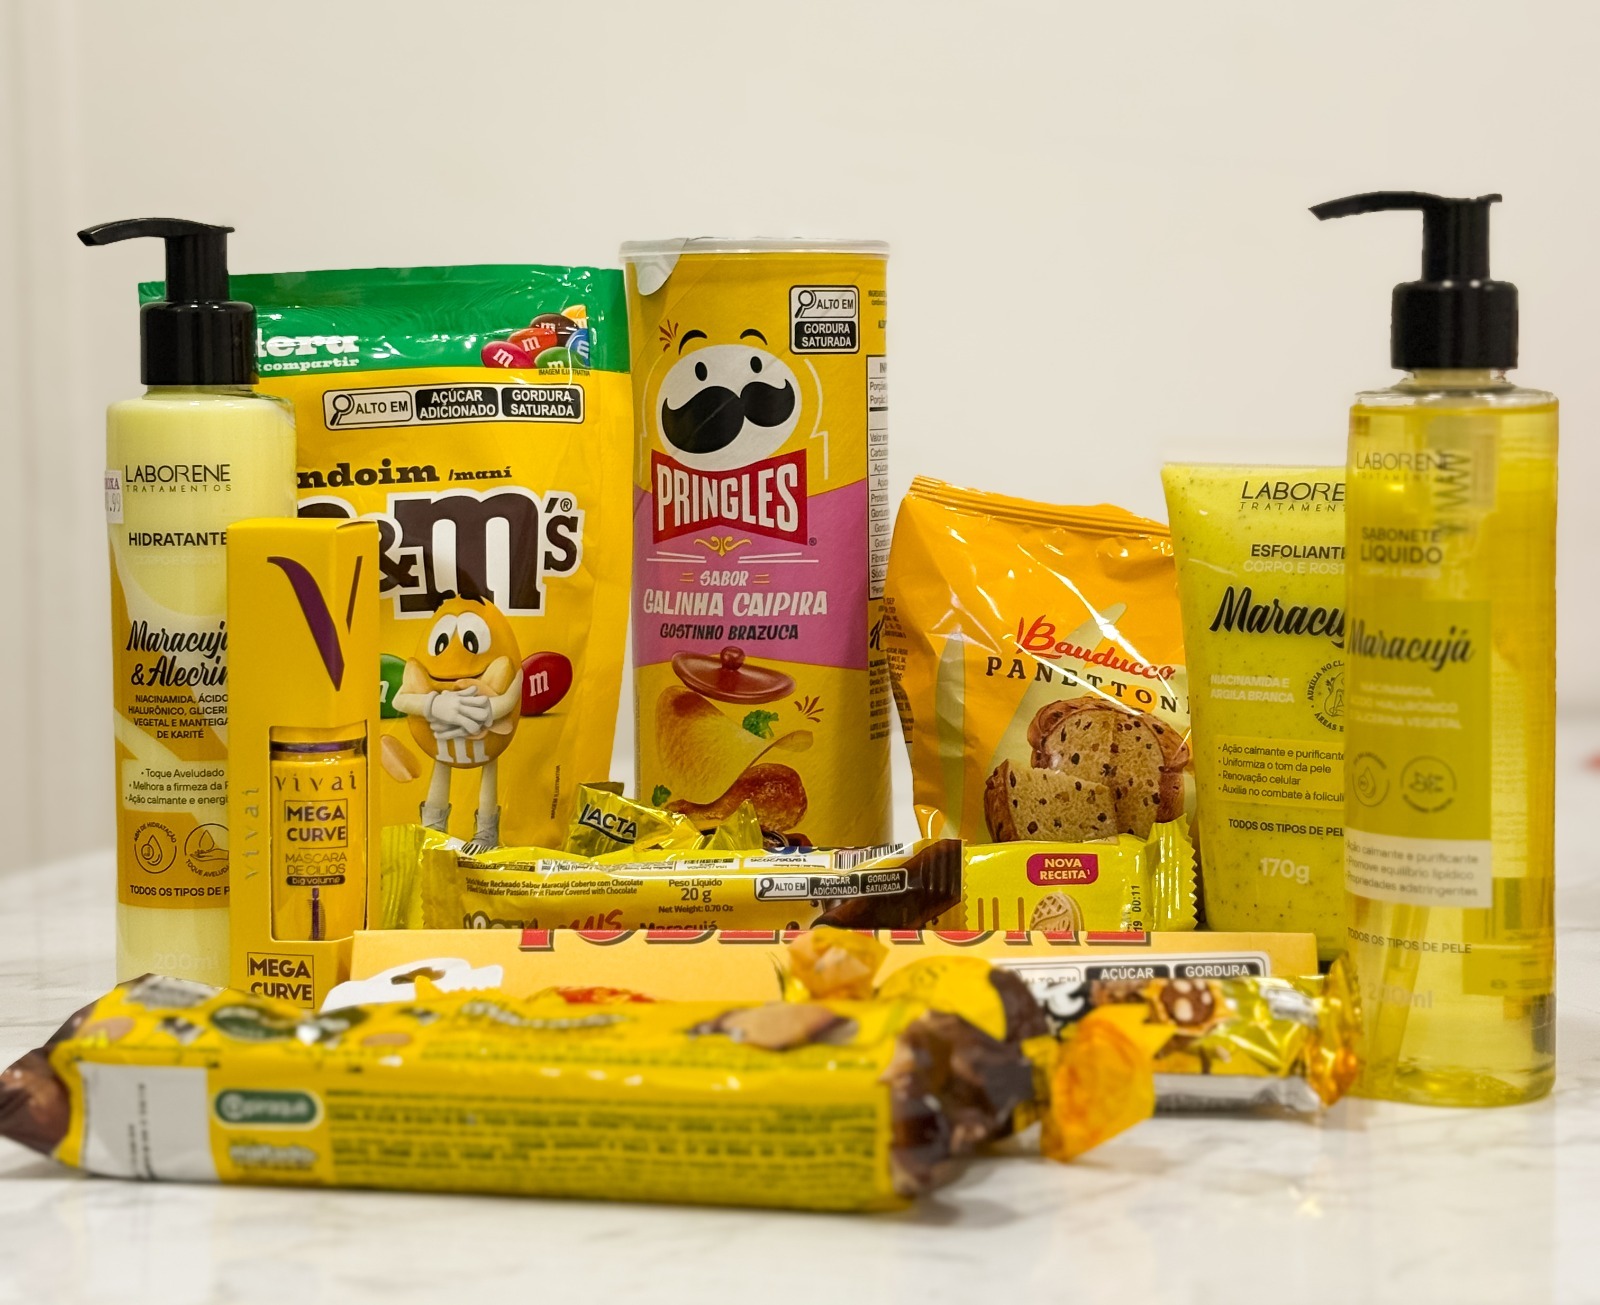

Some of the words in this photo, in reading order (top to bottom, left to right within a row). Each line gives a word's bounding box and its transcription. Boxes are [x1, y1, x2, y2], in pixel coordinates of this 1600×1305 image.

[816, 299, 840, 310] ALTO
[842, 299, 854, 309] EM
[804, 323, 850, 335] GORDURA
[801, 336, 852, 348] SATURADA
[263, 356, 359, 371] compartir
[431, 388, 483, 407] AÇÚCAR
[512, 389, 572, 401] GORDURA
[356, 402, 387, 414] ALTO
[391, 401, 408, 413] EM
[420, 404, 496, 419] ADICIONADO
[511, 404, 574, 417] SATURADA
[126, 464, 231, 483] LABORENE
[126, 484, 232, 493] TRATAMENTOS
[656, 463, 799, 533] PRINGLES
[128, 532, 228, 547] HIDRATANTE
[1362, 527, 1440, 543] SABONETE
[1243, 560, 1294, 573] CORPO
[1297, 562, 1306, 574] E
[700, 570, 749, 587] SABOR
[643, 588, 724, 617] GALINHA
[732, 590, 828, 617] CAIPIRA
[660, 623, 723, 640] GOSTINHO
[728, 624, 799, 641] BRAZUCA
[1016, 614, 1175, 682] Bauducco
[1348, 617, 1473, 673] Maracujá
[986, 656, 1190, 714] PANETTON
[1211, 674, 1280, 689] NIACINAMIDA
[1282, 678, 1290, 689] E
[1307, 671, 1323, 701] AUXILIA
[1321, 663, 1333, 674] NO
[135, 694, 196, 704] NIACINAMIDA,
[1211, 688, 1246, 701] ARGILA
[1248, 690, 1295, 703] BRANCA
[128, 705, 187, 716] HIALURÔNICO,
[134, 718, 169, 727] VEGETAL
[171, 718, 178, 727] E
[157, 730, 169, 739] DE
[171, 728, 204, 739] KARITÉ
[1222, 743, 1243, 754] Ação
[1244, 745, 1285, 757] calmante
[1287, 749, 1294, 757] e
[146, 768, 172, 779] Toque
[173, 768, 225, 778] Aveludado
[1222, 757, 1265, 770] Uniformiza
[1267, 761, 1274, 770] o
[1275, 761, 1294, 771] tom
[1295, 760, 1308, 772] da
[1310, 763, 1332, 776] pele
[274, 771, 357, 792] vivai
[1222, 770, 1268, 785] Renovação
[1269, 774, 1301, 786] celular
[133, 781, 164, 791] Melhora
[173, 782, 208, 791] firmeza
[210, 781, 222, 790] da
[1222, 784, 1247, 796] Auxilia
[1248, 787, 1260, 797] no
[1261, 788, 1303, 800] combate
[1304, 789, 1311, 800] à
[128, 794, 146, 805] Ação
[147, 795, 187, 805] calmante
[190, 797, 196, 805] e
[287, 805, 345, 822] MEGA
[578, 803, 639, 838] LACTA
[287, 826, 346, 842] CURVE
[1228, 818, 1258, 831] TODOS
[1259, 820, 1274, 832] OS
[1275, 822, 1307, 835] TIPOS
[1308, 824, 1324, 836] DE
[1362, 846, 1405, 859] calmante
[1406, 852, 1413, 860] e
[1416, 852, 1478, 864] purificante
[186, 859, 203, 876] TOQUE
[287, 864, 304, 875] DE
[1044, 858, 1082, 868] NOVA
[1260, 857, 1310, 884] 170g
[292, 877, 306, 886] big
[306, 876, 341, 885] volume
[490, 879, 521, 888] Recheado
[522, 881, 541, 889] Sabor
[541, 880, 570, 890] Maracujá
[571, 880, 597, 888] Coberto
[612, 878, 644, 887] Chocolate
[669, 879, 690, 888] Peso
[691, 878, 722, 888] Líquido
[820, 875, 851, 887] AÇÚCAR
[868, 873, 901, 883] GORDURA
[130, 885, 157, 896] TODOS
[159, 888, 172, 897] OS
[174, 888, 205, 897] TIPOS
[207, 887, 222, 897] DE
[506, 888, 529, 897] Passion
[545, 888, 564, 896] Flavor
[565, 888, 591, 896] Covered
[592, 887, 605, 895] with
[606, 887, 637, 895] Chocolate
[775, 883, 794, 893] ALTO
[795, 882, 806, 891] EM
[812, 885, 858, 896] ADICIONADO
[865, 883, 901, 893] SATURADA
[681, 888, 699, 901] 20
[702, 889, 712, 903] g
[658, 905, 674, 914] Net
[674, 905, 703, 914] Weight:
[704, 904, 721, 912] 0.70
[722, 904, 734, 912] Oz
[1347, 926, 1370, 943] TODOS
[1371, 934, 1385, 946] OS
[1387, 937, 1420, 951] TIPOS
[1422, 941, 1439, 953] DE
[1441, 942, 1472, 954] PELE
[250, 958, 311, 978] MEGA
[1100, 965, 1154, 980] AÇÚCAR
[1185, 964, 1250, 978] GORDURA
[251, 981, 312, 1001] CURVE
